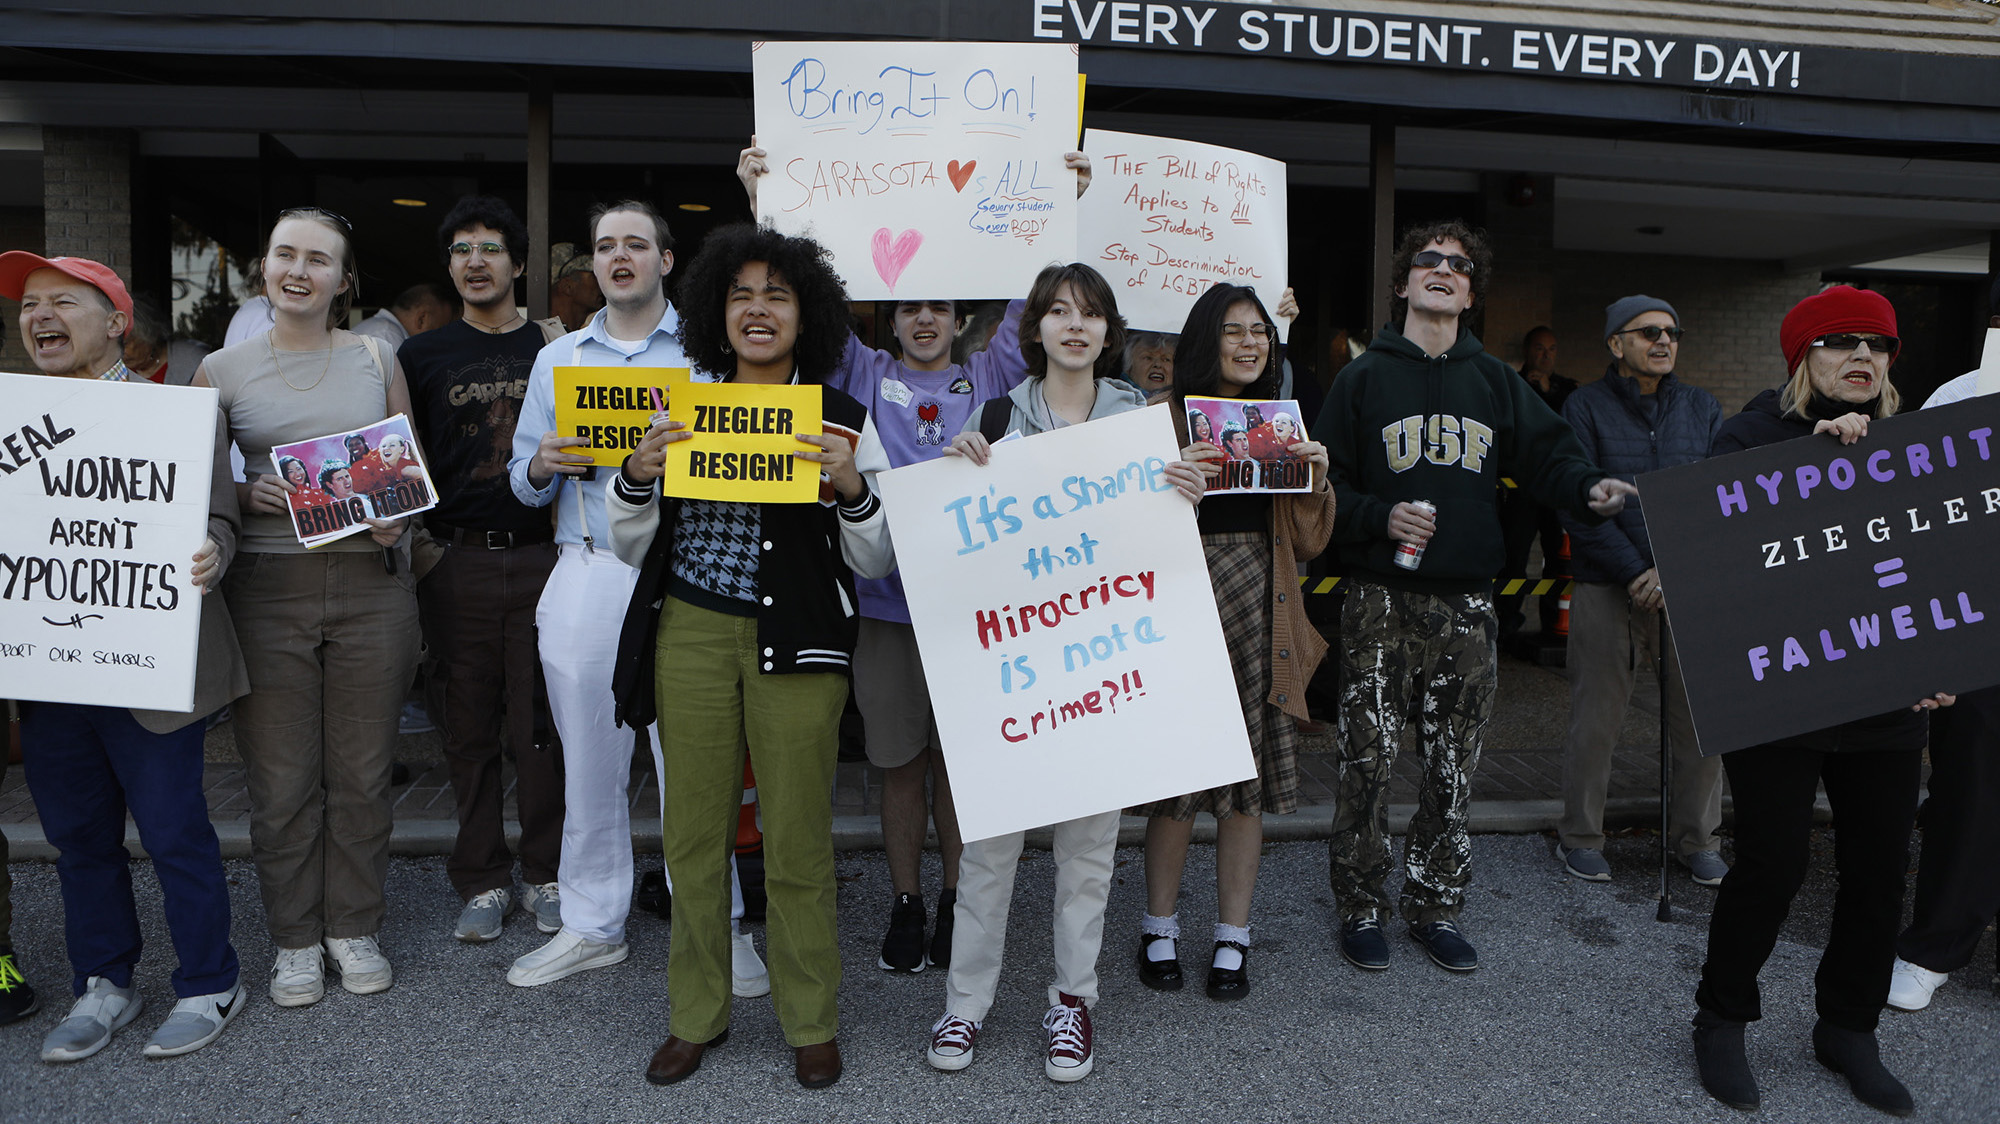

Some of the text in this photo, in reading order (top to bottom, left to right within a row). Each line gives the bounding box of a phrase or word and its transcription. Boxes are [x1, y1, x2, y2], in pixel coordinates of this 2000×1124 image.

[1033, 0, 1800, 89] EVERY STUDENT. EVERY DAY!
[781, 58, 1037, 135] Bring It On!
[781, 158, 940, 212] SARASOTA
[994, 160, 1054, 196] ALL
[1104, 154, 1148, 176] THE
[1204, 160, 1220, 184] of
[1224, 162, 1266, 201] Rights
[1124, 183, 1250, 219] Applies to All
[988, 202, 1055, 212] every student
[1141, 215, 1214, 241] Students
[1100, 243, 1262, 278] Stop Descrimination
[1127, 269, 1222, 296] of LGBT
[576, 386, 664, 410] ZIEGLER
[693, 405, 793, 434] ZIEGLER
[576, 425, 653, 450] RESIG
[1382, 414, 1493, 474] USF
[39, 456, 176, 503] WOMEN
[689, 451, 794, 482] RESIGN!
[1259, 461, 1277, 488] IT
[1282, 459, 1309, 489] ON
[296, 479, 430, 538] BRING IT ON
[944, 483, 1023, 557] It's
[1032, 495, 1067, 519] a
[1762, 487, 2000, 569] ZIEGLER
[50, 517, 138, 549] AREN'T
[1021, 532, 1099, 581] that
[0, 553, 178, 610] YPOCRITES
[49, 647, 82, 664] OUR
[93, 650, 155, 669] SCHOOLS
[1001, 616, 1167, 693] is not a
[1748, 592, 1984, 681] FALWELL
